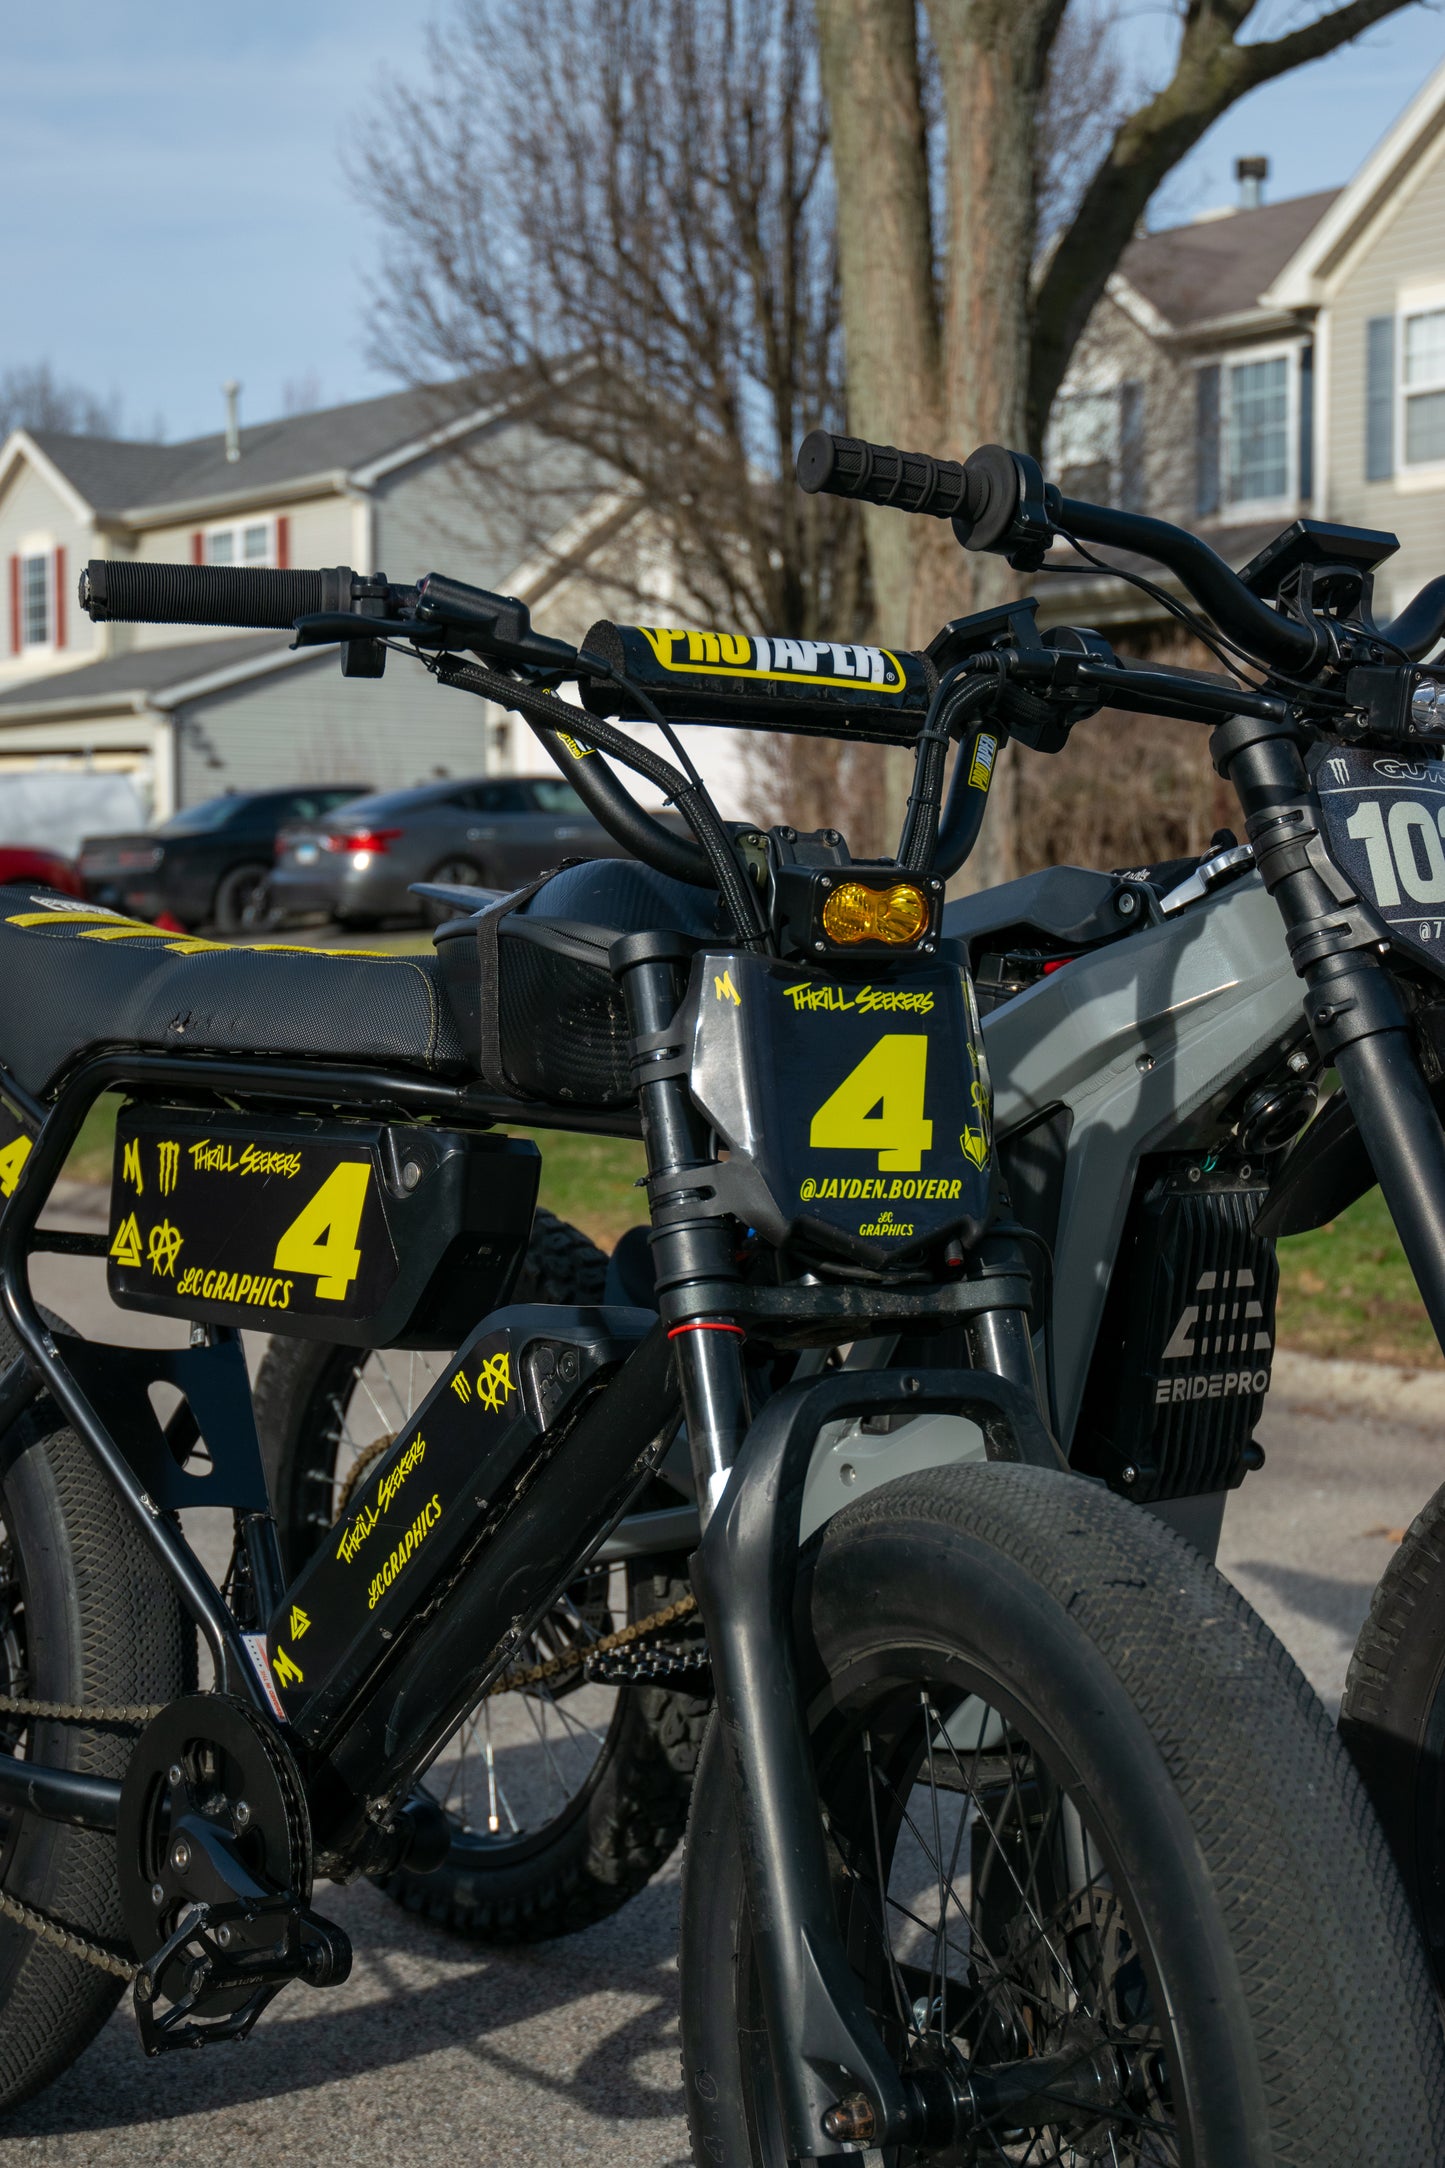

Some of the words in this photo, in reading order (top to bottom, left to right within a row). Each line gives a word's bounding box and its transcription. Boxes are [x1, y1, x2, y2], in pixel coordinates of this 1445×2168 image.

[1347, 800, 1445, 907] 10
[810, 1034, 933, 1172] 4
[0, 1134, 34, 1199] 4
[800, 1178, 963, 1202] @JAYDEN.BOYERR
[272, 1161, 372, 1301] 4
[859, 1223, 914, 1237] GRAPHICS
[1155, 1369, 1268, 1404] ERIDEPRO
